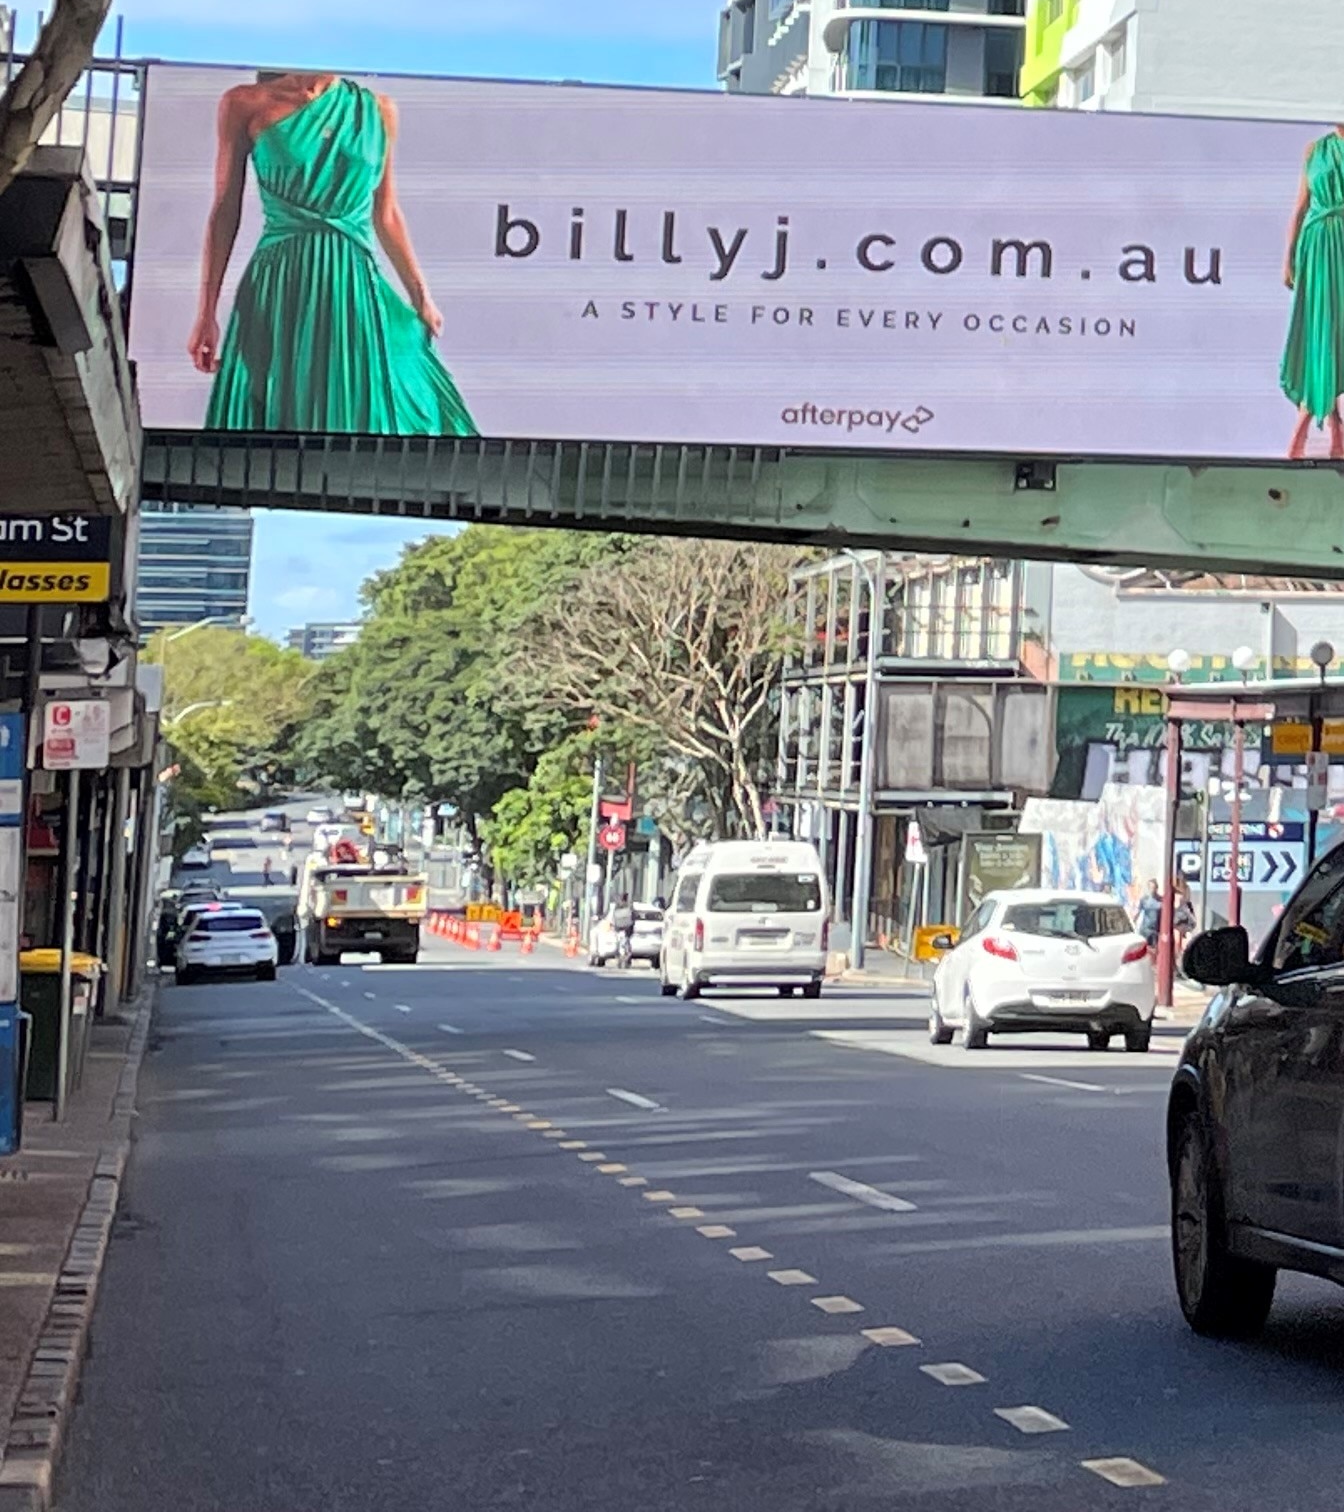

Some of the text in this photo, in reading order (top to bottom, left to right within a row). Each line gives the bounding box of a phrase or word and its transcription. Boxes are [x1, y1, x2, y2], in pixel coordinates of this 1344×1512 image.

[494, 203, 1223, 285] billyj.com.au
[581, 300, 1139, 338] A STYLE FOR EVERY OCCASION
[781, 402, 901, 434] afterpay
[51, 516, 89, 542] St
